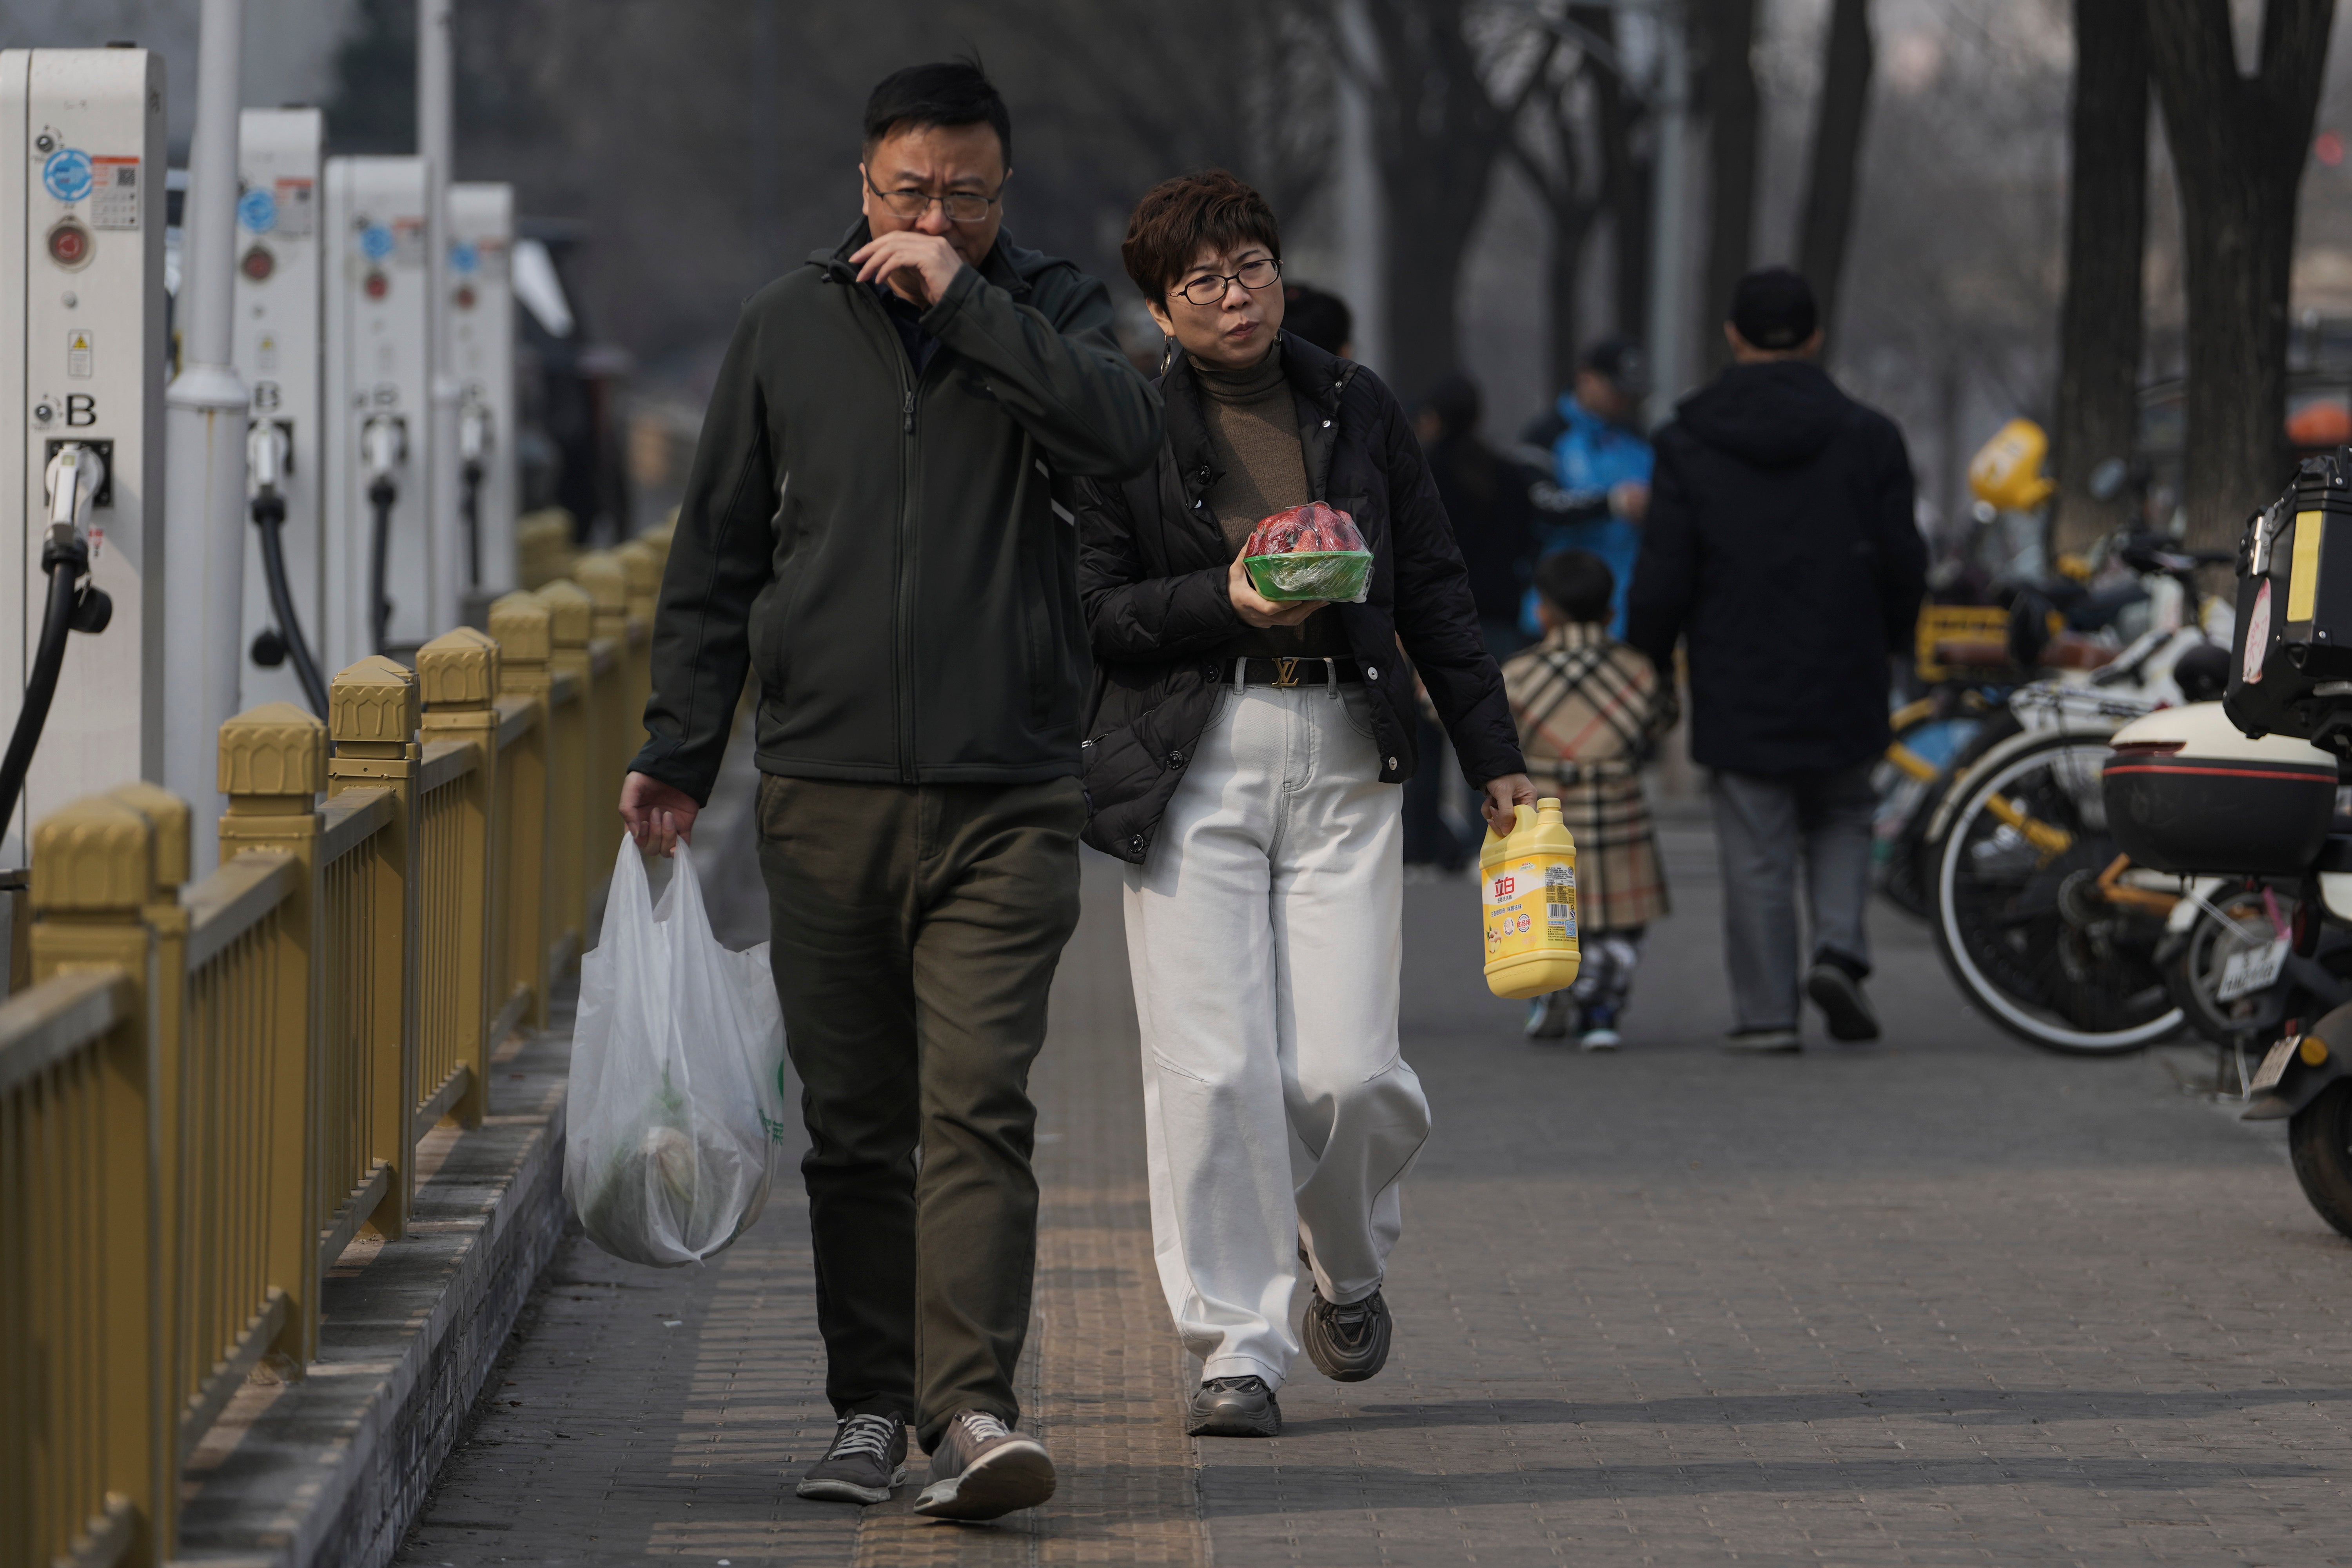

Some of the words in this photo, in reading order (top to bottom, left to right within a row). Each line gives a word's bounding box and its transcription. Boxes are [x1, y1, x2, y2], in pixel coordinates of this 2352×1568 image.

[67, 394, 96, 425] B
[1495, 877, 1515, 897] 立白
[1517, 919, 1531, 928] 食品用
